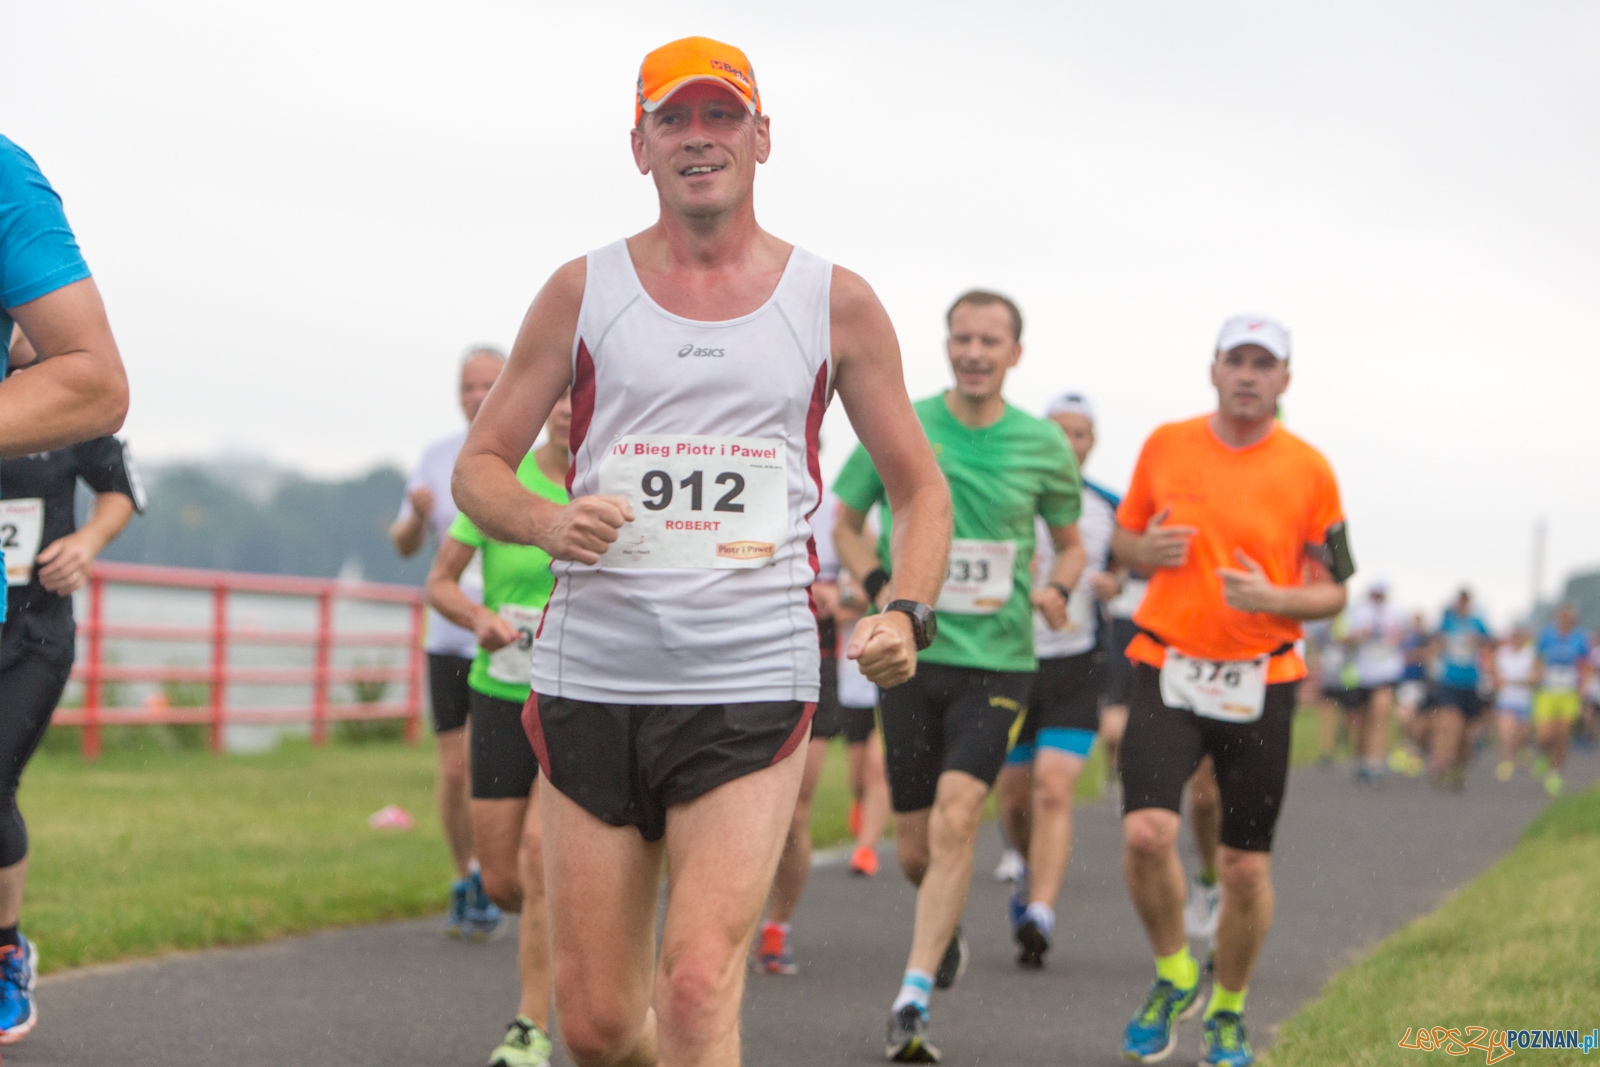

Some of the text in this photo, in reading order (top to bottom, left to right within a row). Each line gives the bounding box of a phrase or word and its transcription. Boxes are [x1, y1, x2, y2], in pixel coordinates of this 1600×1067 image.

[693, 347, 725, 358] asics
[613, 443, 777, 459] IV Bieg Piotr i Paweł
[641, 470, 745, 513] 912
[665, 520, 721, 531] ROBERT
[718, 545, 739, 554] Piotr
[947, 559, 990, 582] 33
